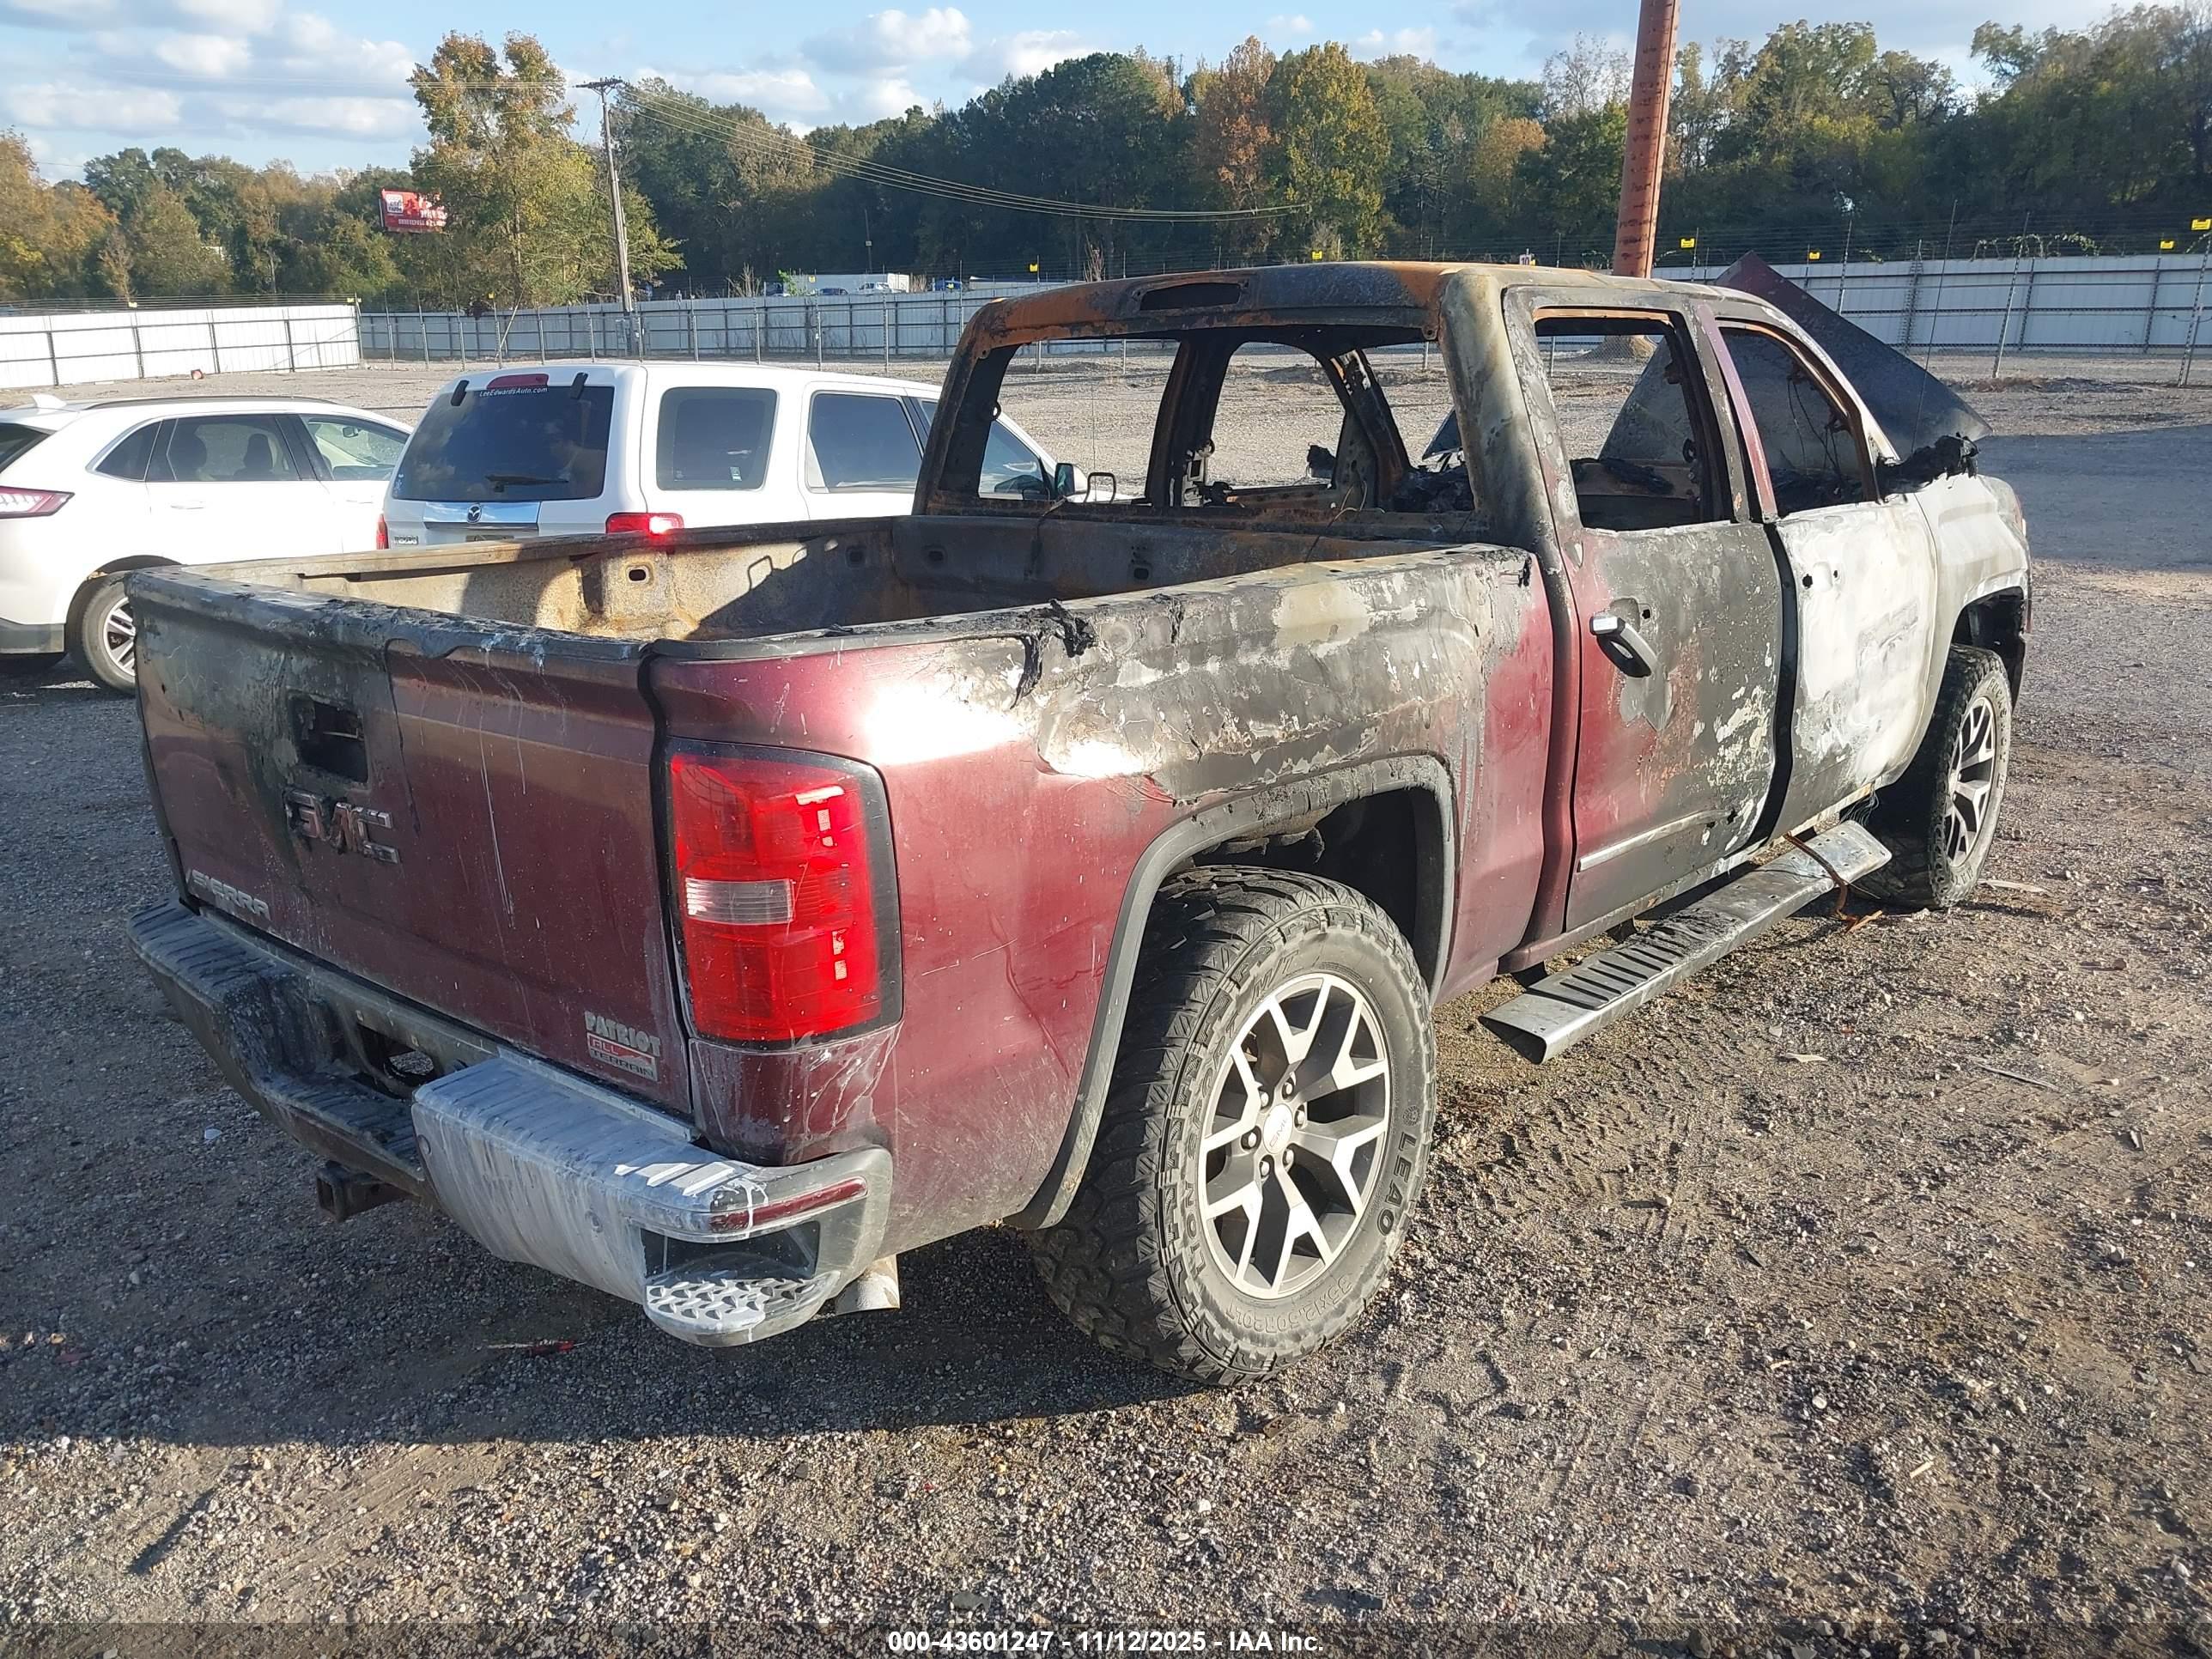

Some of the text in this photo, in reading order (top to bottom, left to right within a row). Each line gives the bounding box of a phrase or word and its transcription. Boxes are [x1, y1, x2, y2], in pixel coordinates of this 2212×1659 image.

[479, 387, 548, 397] LeeEdwardsAuto.com
[283, 787, 399, 865] GMC
[584, 1010, 660, 1057] PATRIOT
[591, 1048, 654, 1078] TERRAIN
[1376, 1131, 1417, 1237] LEAO
